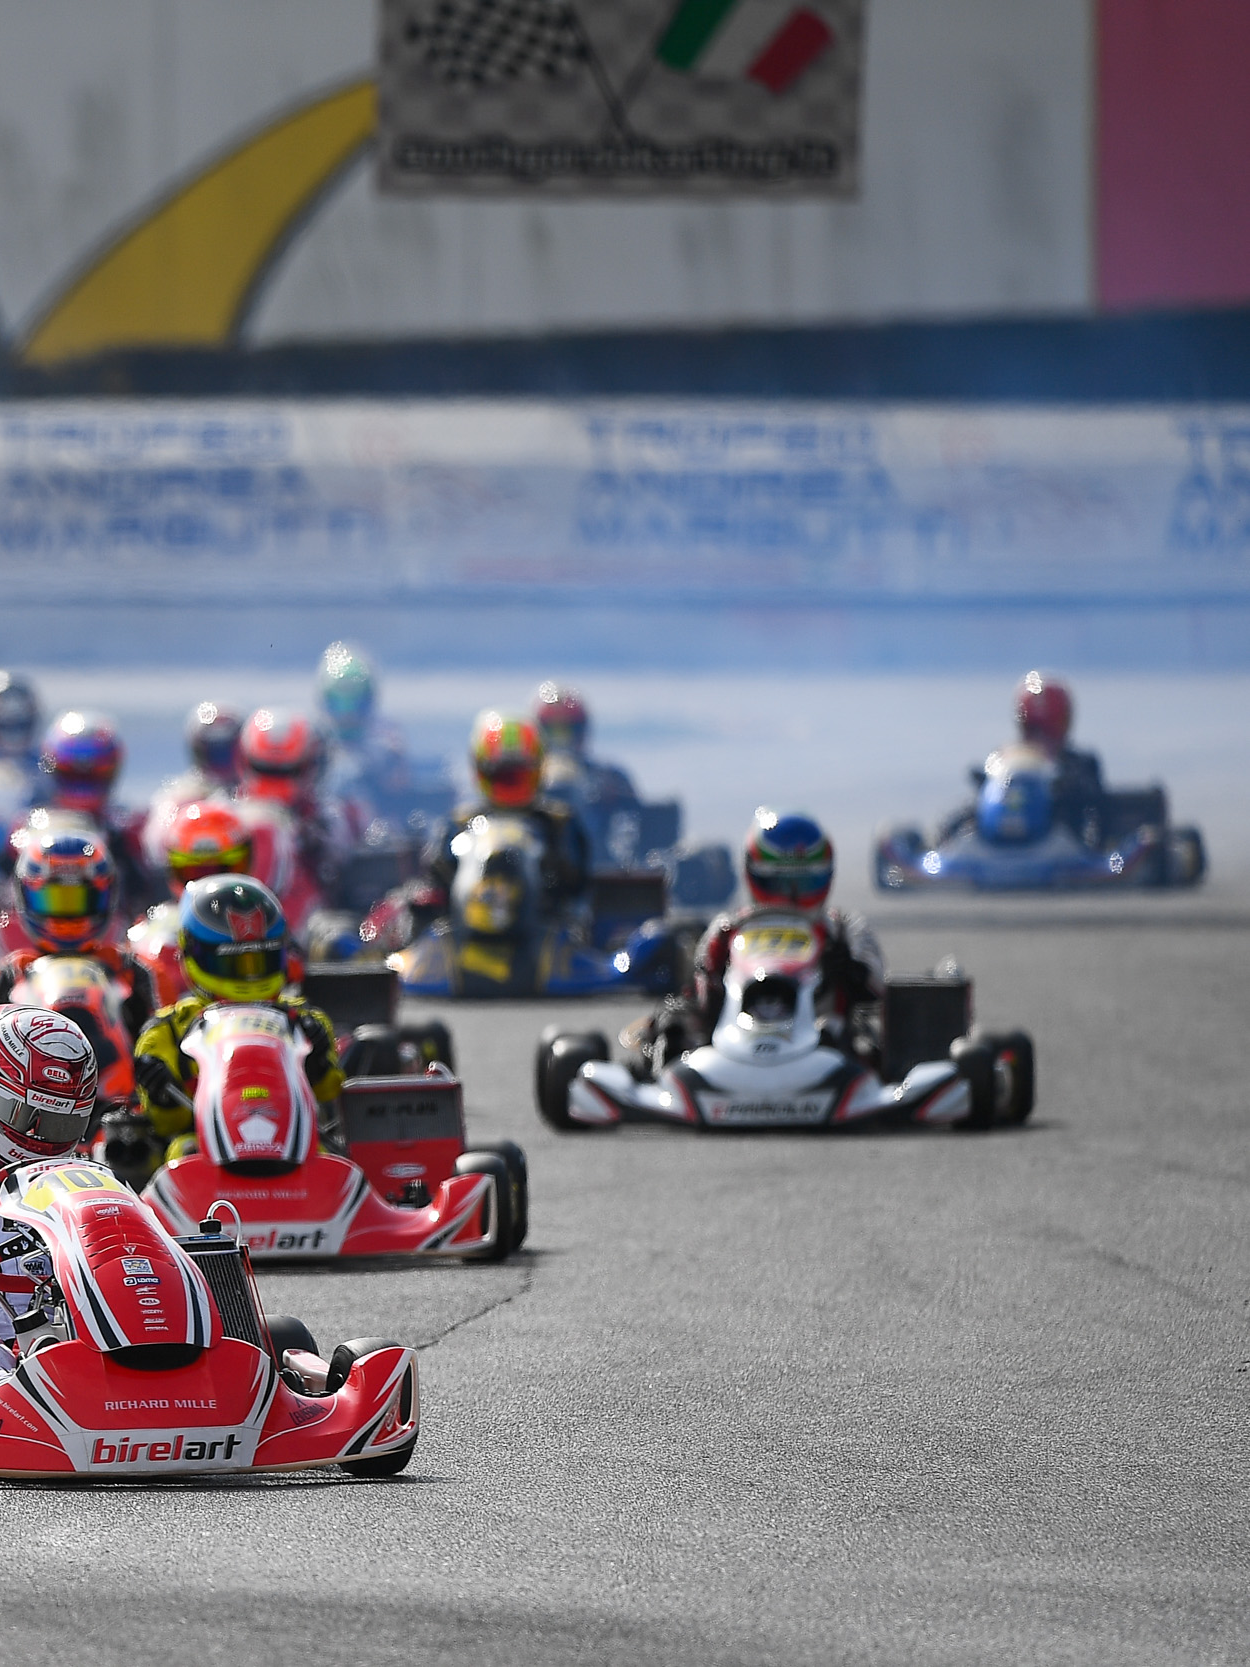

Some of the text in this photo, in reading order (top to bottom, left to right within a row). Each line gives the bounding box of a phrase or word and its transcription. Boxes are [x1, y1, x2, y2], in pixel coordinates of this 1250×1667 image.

[8, 1039, 25, 1058] MILLE
[46, 1068, 68, 1080] BELL
[31, 1093, 72, 1109] birelart
[228, 1229, 328, 1250] elart
[104, 1399, 217, 1411] RICHARD MILLE
[90, 1433, 243, 1465] birelart
